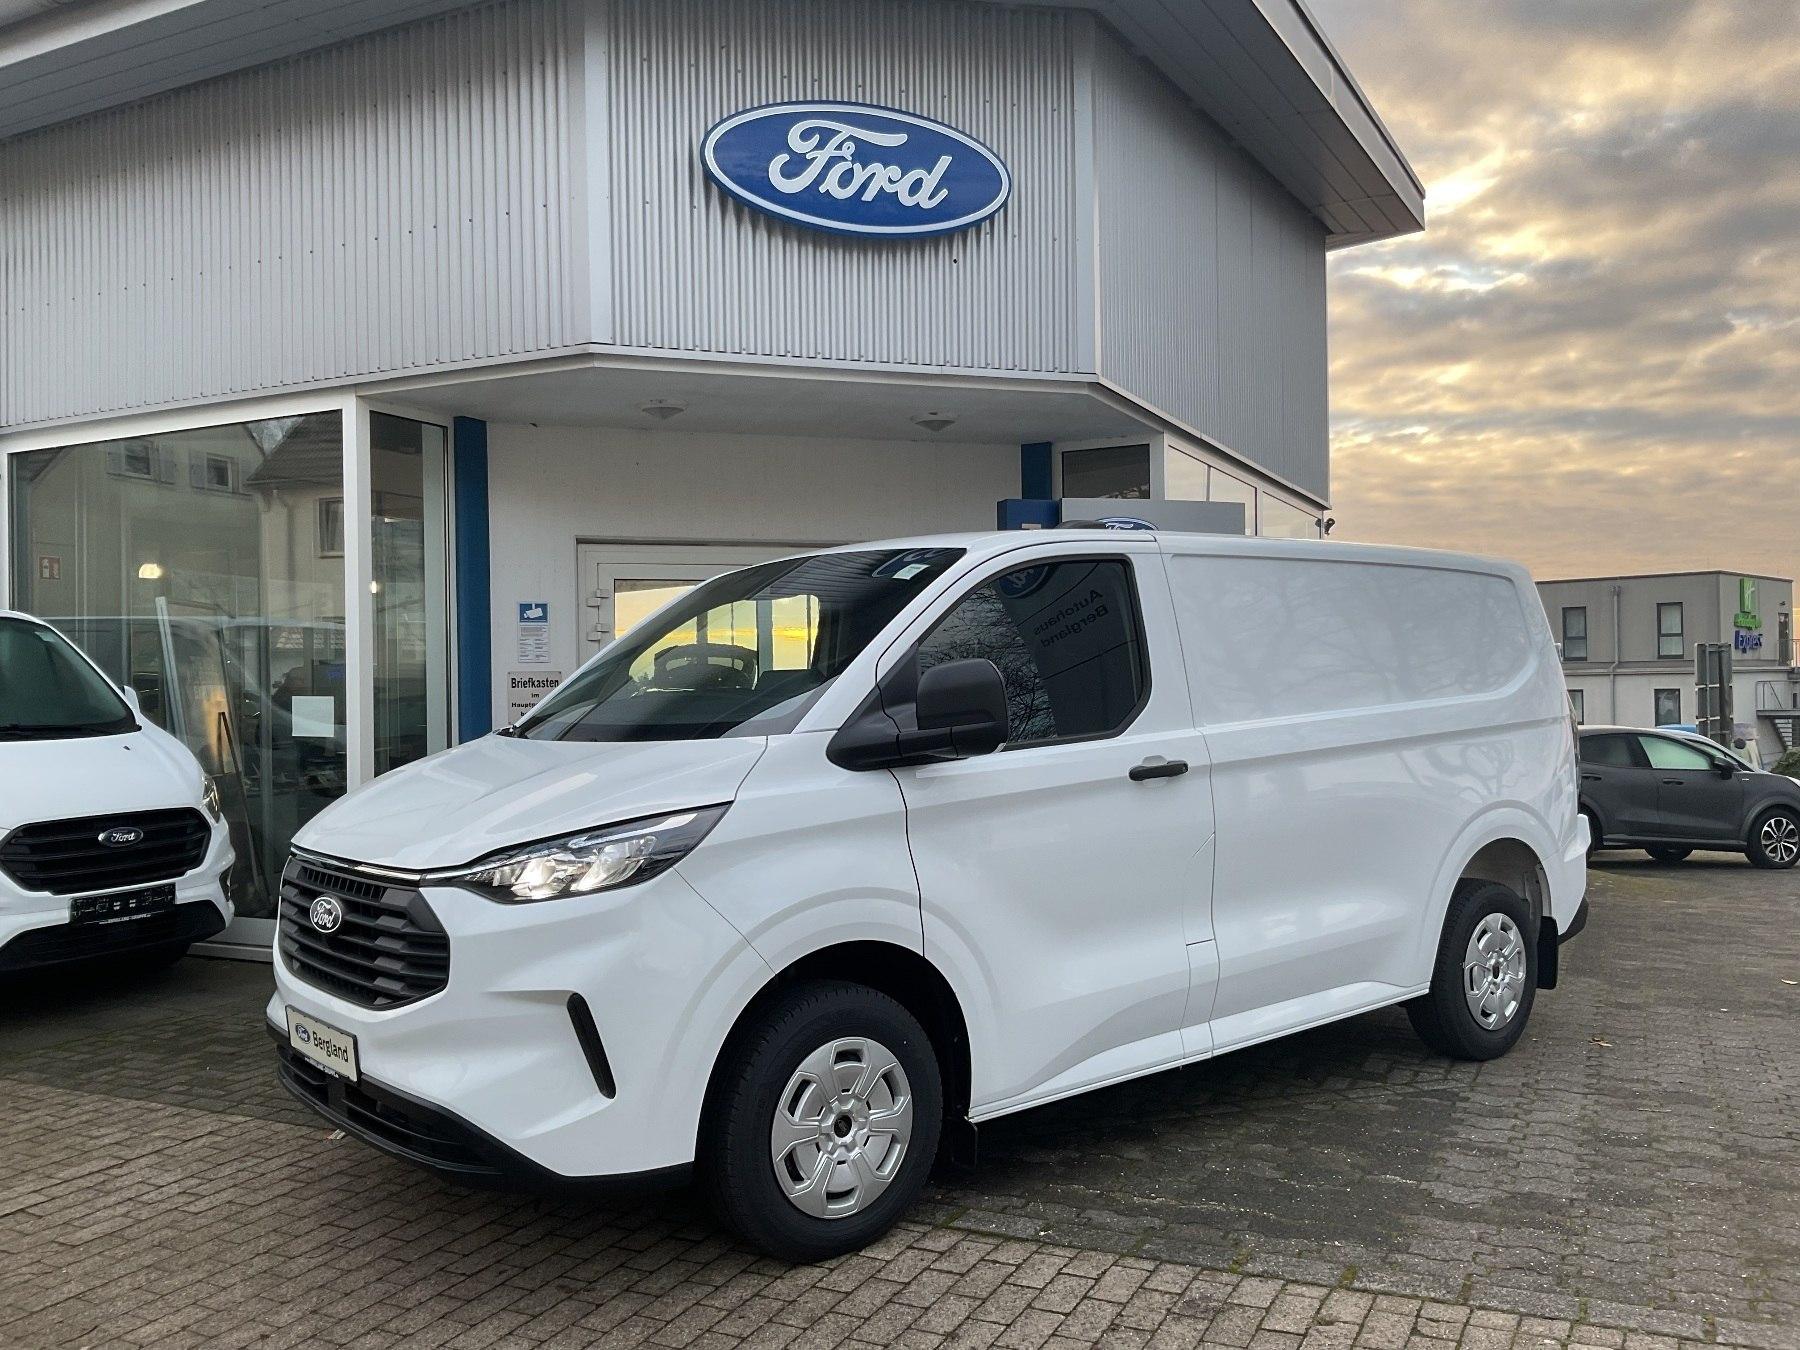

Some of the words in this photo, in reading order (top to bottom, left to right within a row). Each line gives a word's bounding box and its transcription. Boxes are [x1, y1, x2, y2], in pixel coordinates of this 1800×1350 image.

[768, 119, 953, 209] Ford
[511, 677, 559, 689] Briefkasten
[111, 830, 136, 842] Ford
[313, 900, 336, 928] Ford
[312, 1030, 349, 1063] Bergland
